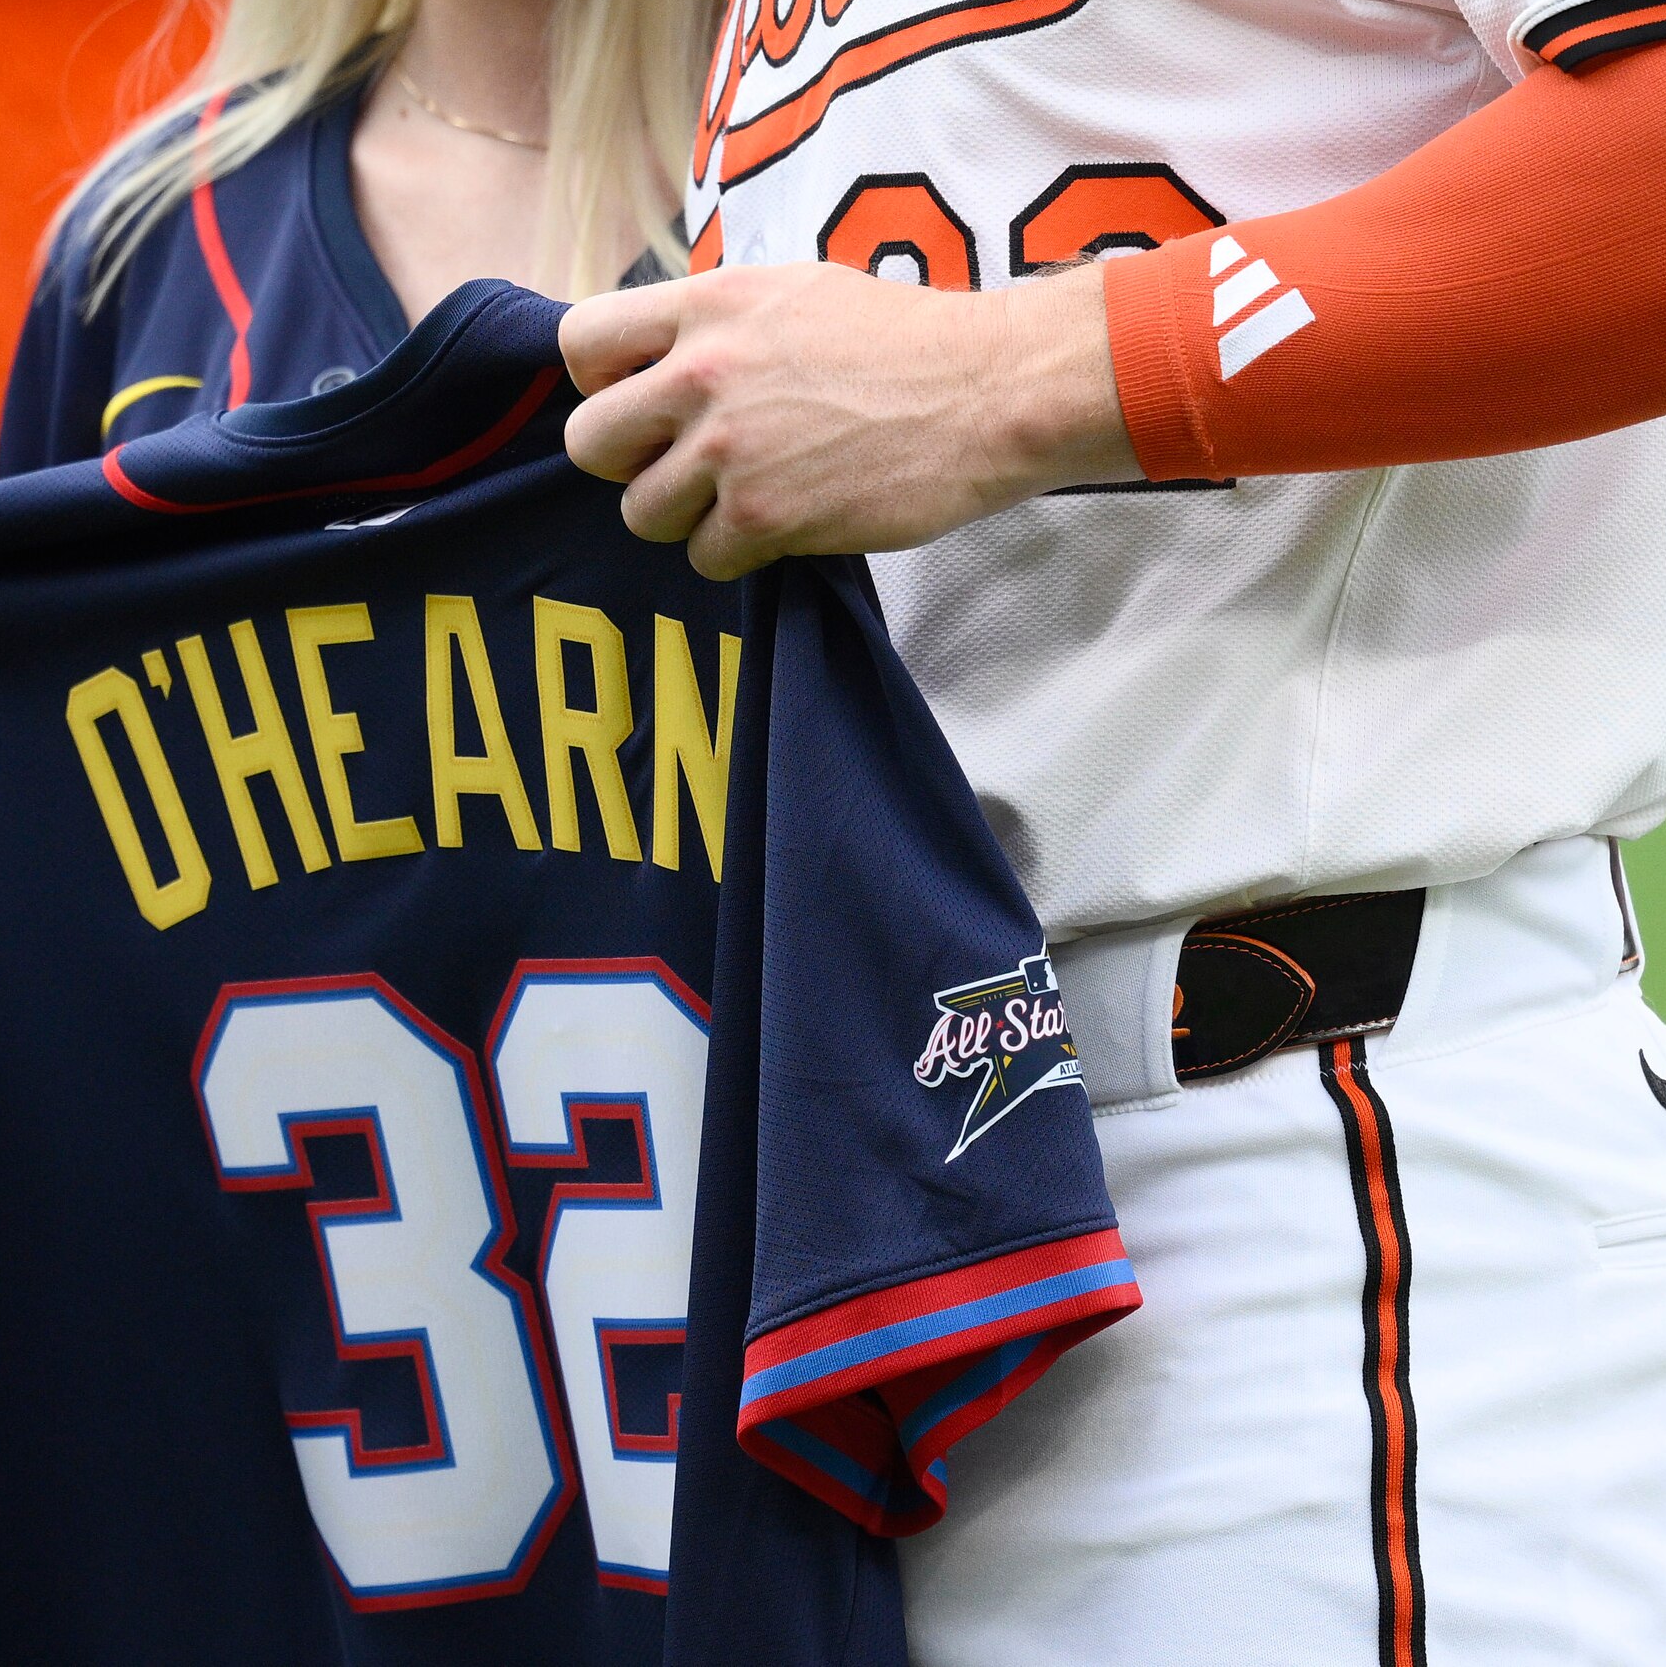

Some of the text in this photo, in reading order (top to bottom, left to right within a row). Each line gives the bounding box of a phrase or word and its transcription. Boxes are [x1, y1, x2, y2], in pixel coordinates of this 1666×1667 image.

[66, 593, 743, 931] O'HEARN
[917, 1010, 991, 1079] All
[190, 956, 713, 1615] 32
